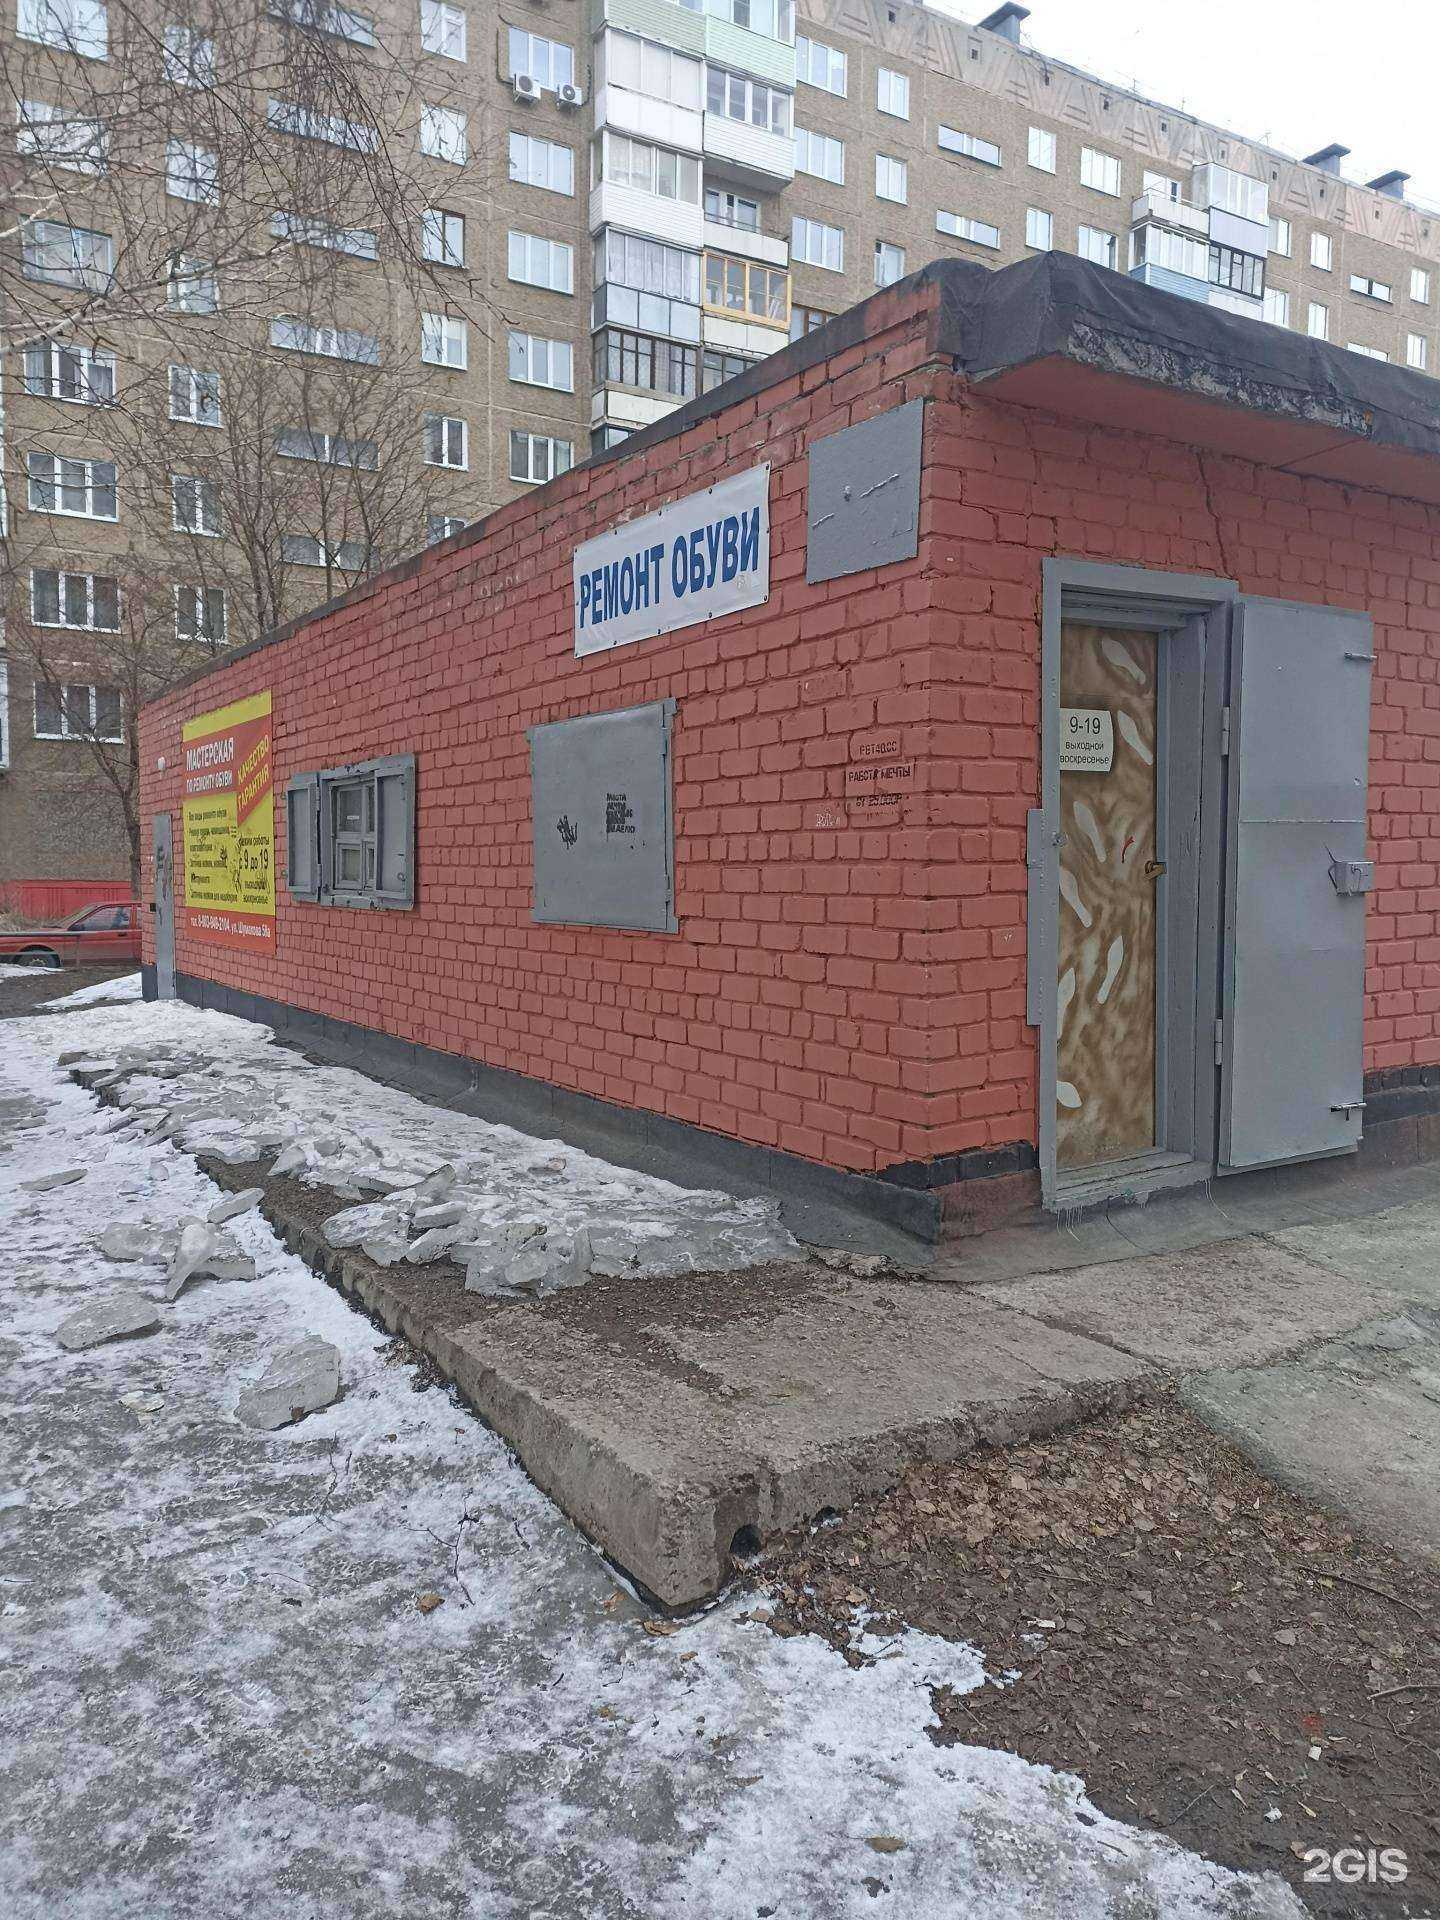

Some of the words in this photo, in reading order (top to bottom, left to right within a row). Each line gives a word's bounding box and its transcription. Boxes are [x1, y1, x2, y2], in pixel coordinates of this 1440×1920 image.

[580, 543, 665, 629] РЕМОНТ
[671, 506, 760, 599] ОБУВИ
[1070, 716, 1101, 735] 9-19
[187, 737, 234, 771] МАСТЕРСКАЯ
[238, 734, 269, 785] КАЧЕСТВО
[194, 774, 214, 792] РЕМОНТУ
[215, 769, 233, 788] ОБУВИ
[239, 764, 269, 812] ГАРАНТИЯ
[848, 768, 879, 782] РАБОТА
[881, 766, 911, 779] МЕЧТЫ
[244, 849, 249, 869] 9
[251, 857, 259, 871] до
[260, 849, 269, 869] 19
